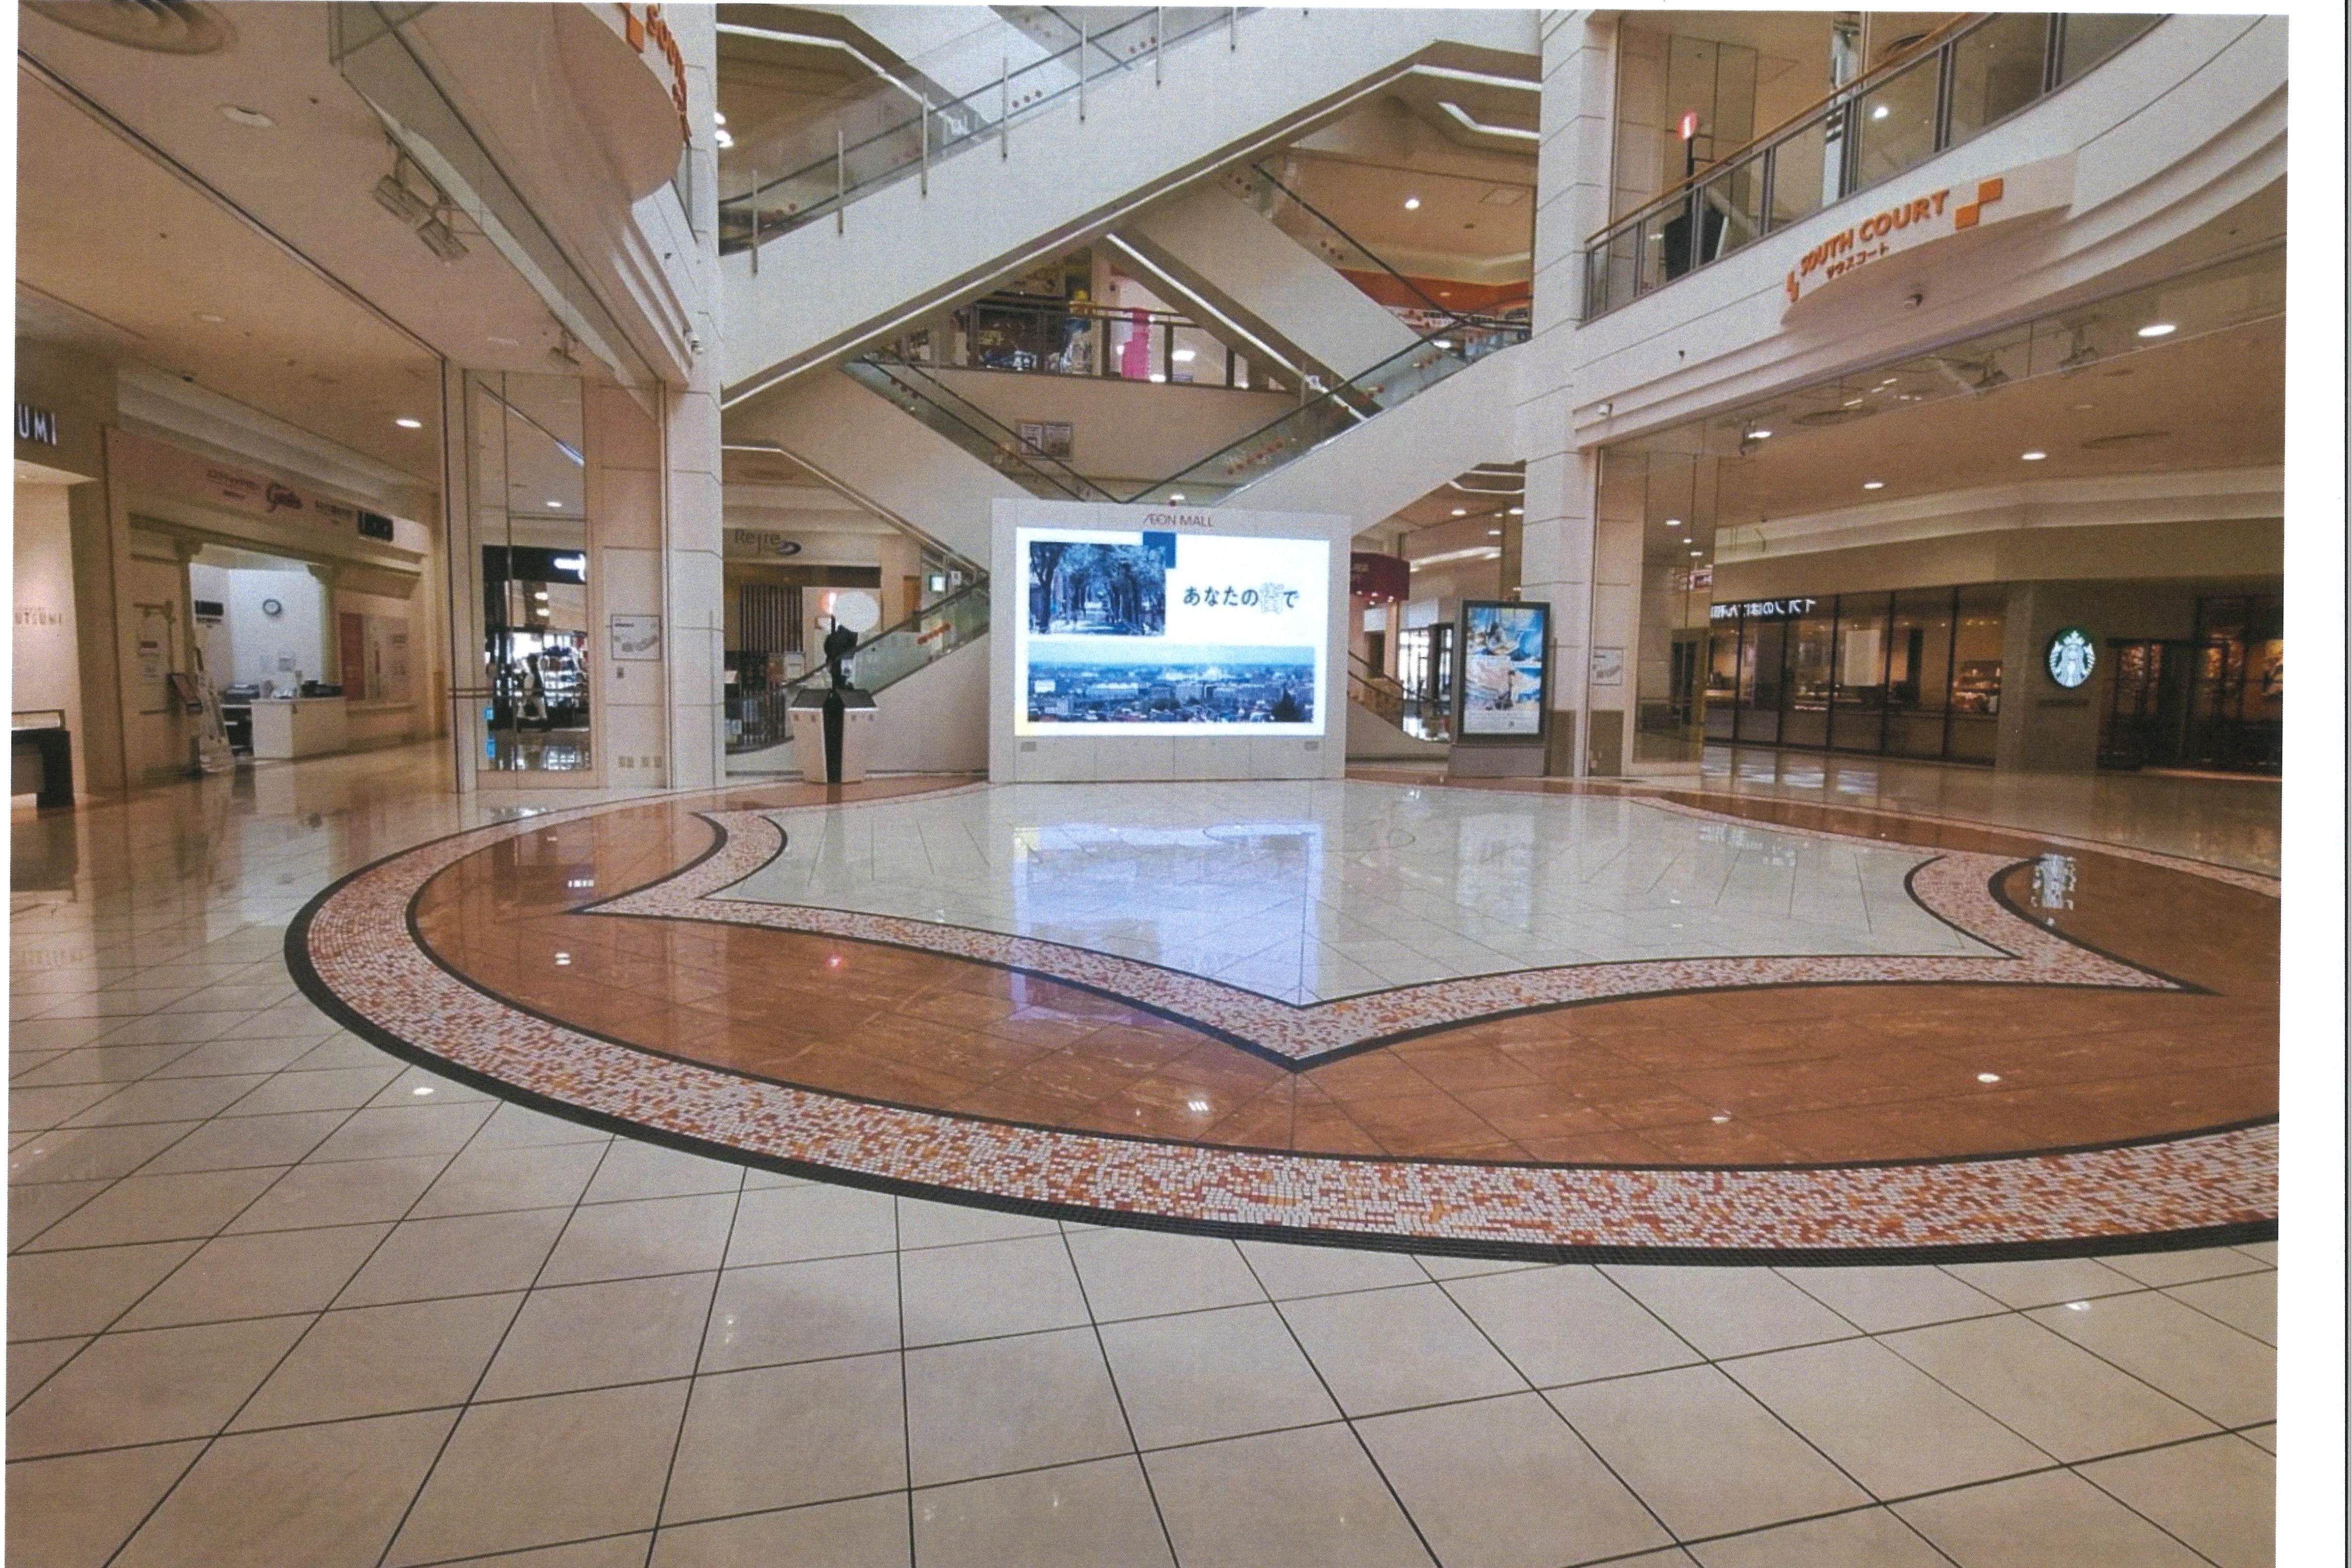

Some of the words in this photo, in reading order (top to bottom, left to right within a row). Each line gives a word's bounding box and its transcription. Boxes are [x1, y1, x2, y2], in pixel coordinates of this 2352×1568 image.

[1800, 229, 1854, 276] SOUTH
[1859, 189, 1950, 242] COURT
[1827, 242, 1889, 278] サウスコート
[18, 403, 57, 446] UMI
[1180, 515, 1215, 527] MALL
